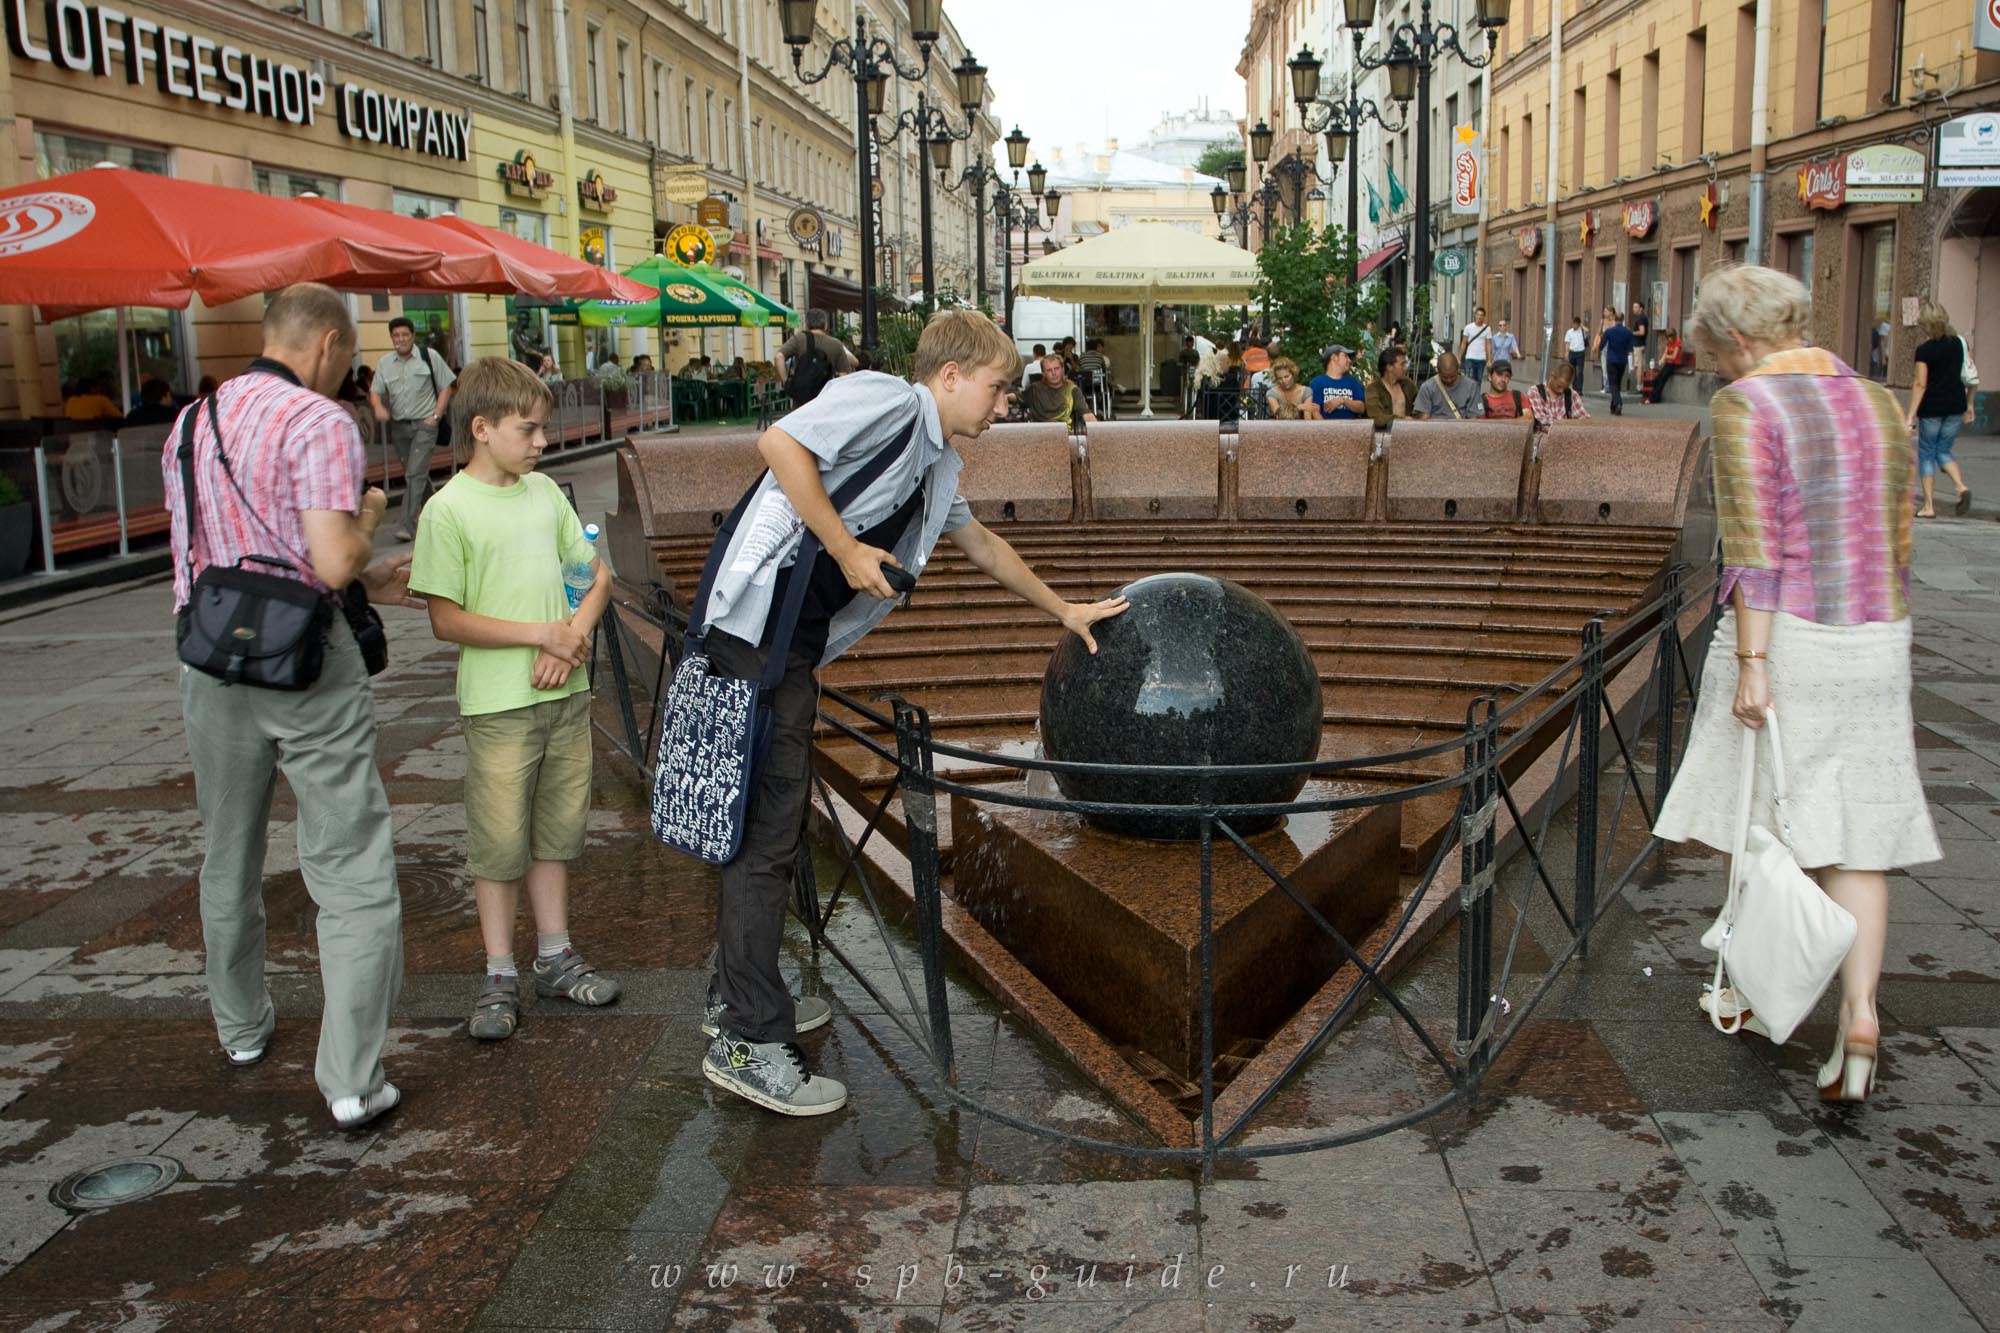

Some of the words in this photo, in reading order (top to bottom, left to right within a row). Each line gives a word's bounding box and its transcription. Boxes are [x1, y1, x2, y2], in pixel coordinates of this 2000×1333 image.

[336, 82, 472, 162] COMPANY
[1038, 271, 1080, 279] БАЛТИКА
[1102, 271, 1145, 279] БАЛТИКА
[1172, 271, 1215, 279] БАЛТИКА
